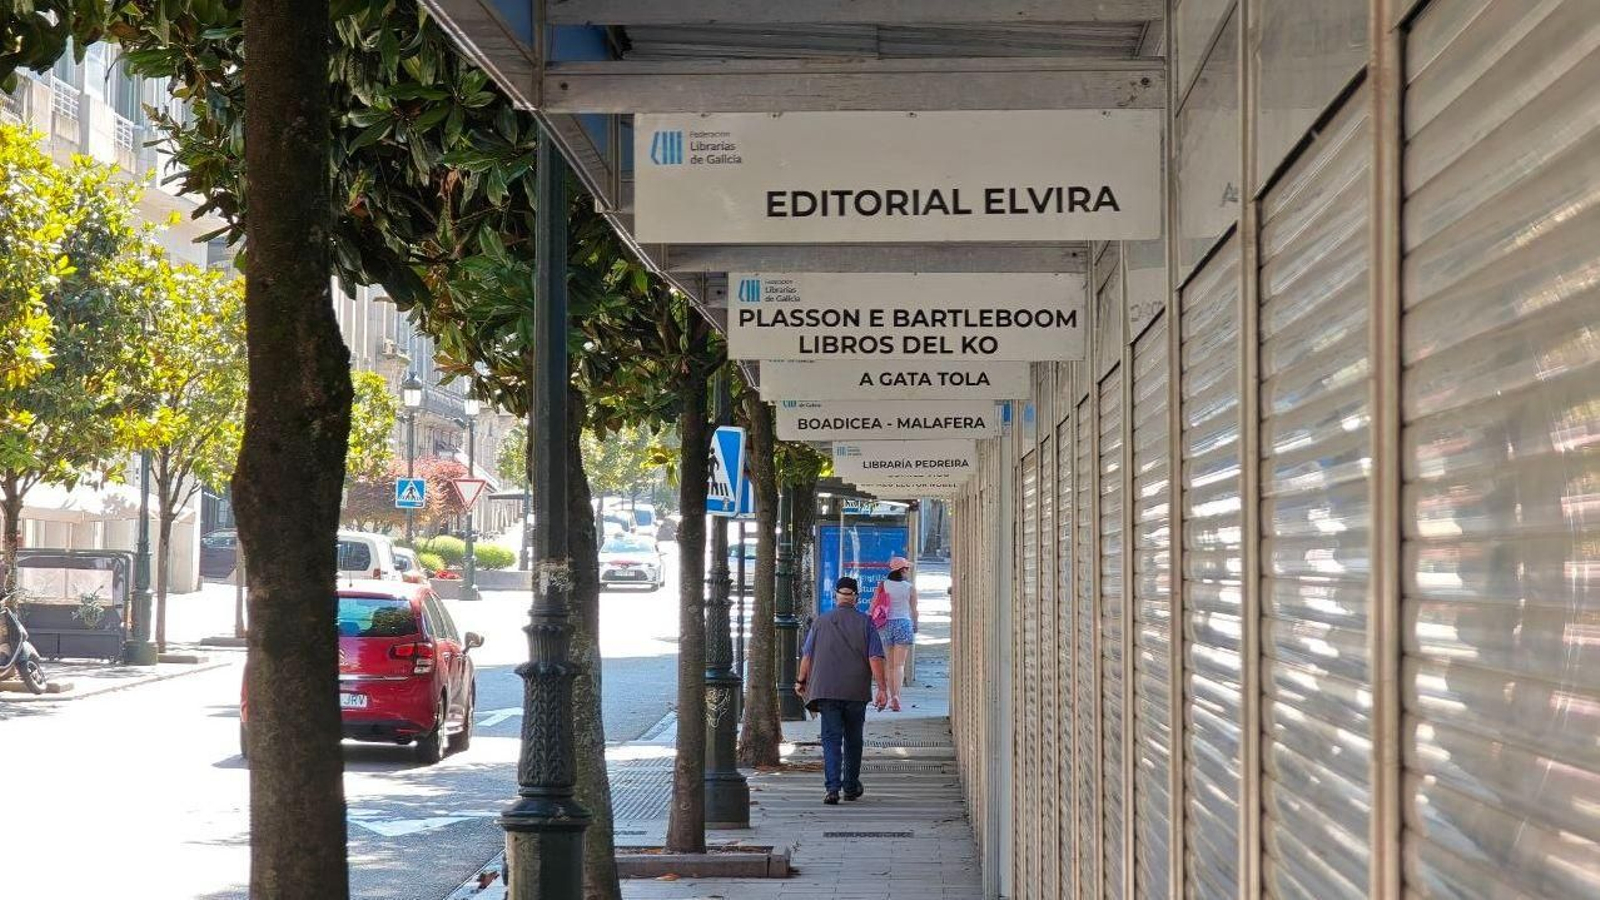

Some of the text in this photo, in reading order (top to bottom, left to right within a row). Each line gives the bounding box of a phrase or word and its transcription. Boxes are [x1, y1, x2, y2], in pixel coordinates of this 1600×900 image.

[690, 154, 742, 165] de Galicia
[767, 186, 1120, 218] EDITORIAL ELVIRA
[740, 309, 1077, 329] PLASSON E BARTLEBOOM
[800, 336, 998, 355] LIBROS DEL KO
[859, 372, 990, 387] A GATA TOLA
[798, 417, 882, 430] BOADICEA
[897, 416, 986, 429] MALAFERA
[863, 458, 970, 469] LIBRARÍA PEDREIRA
